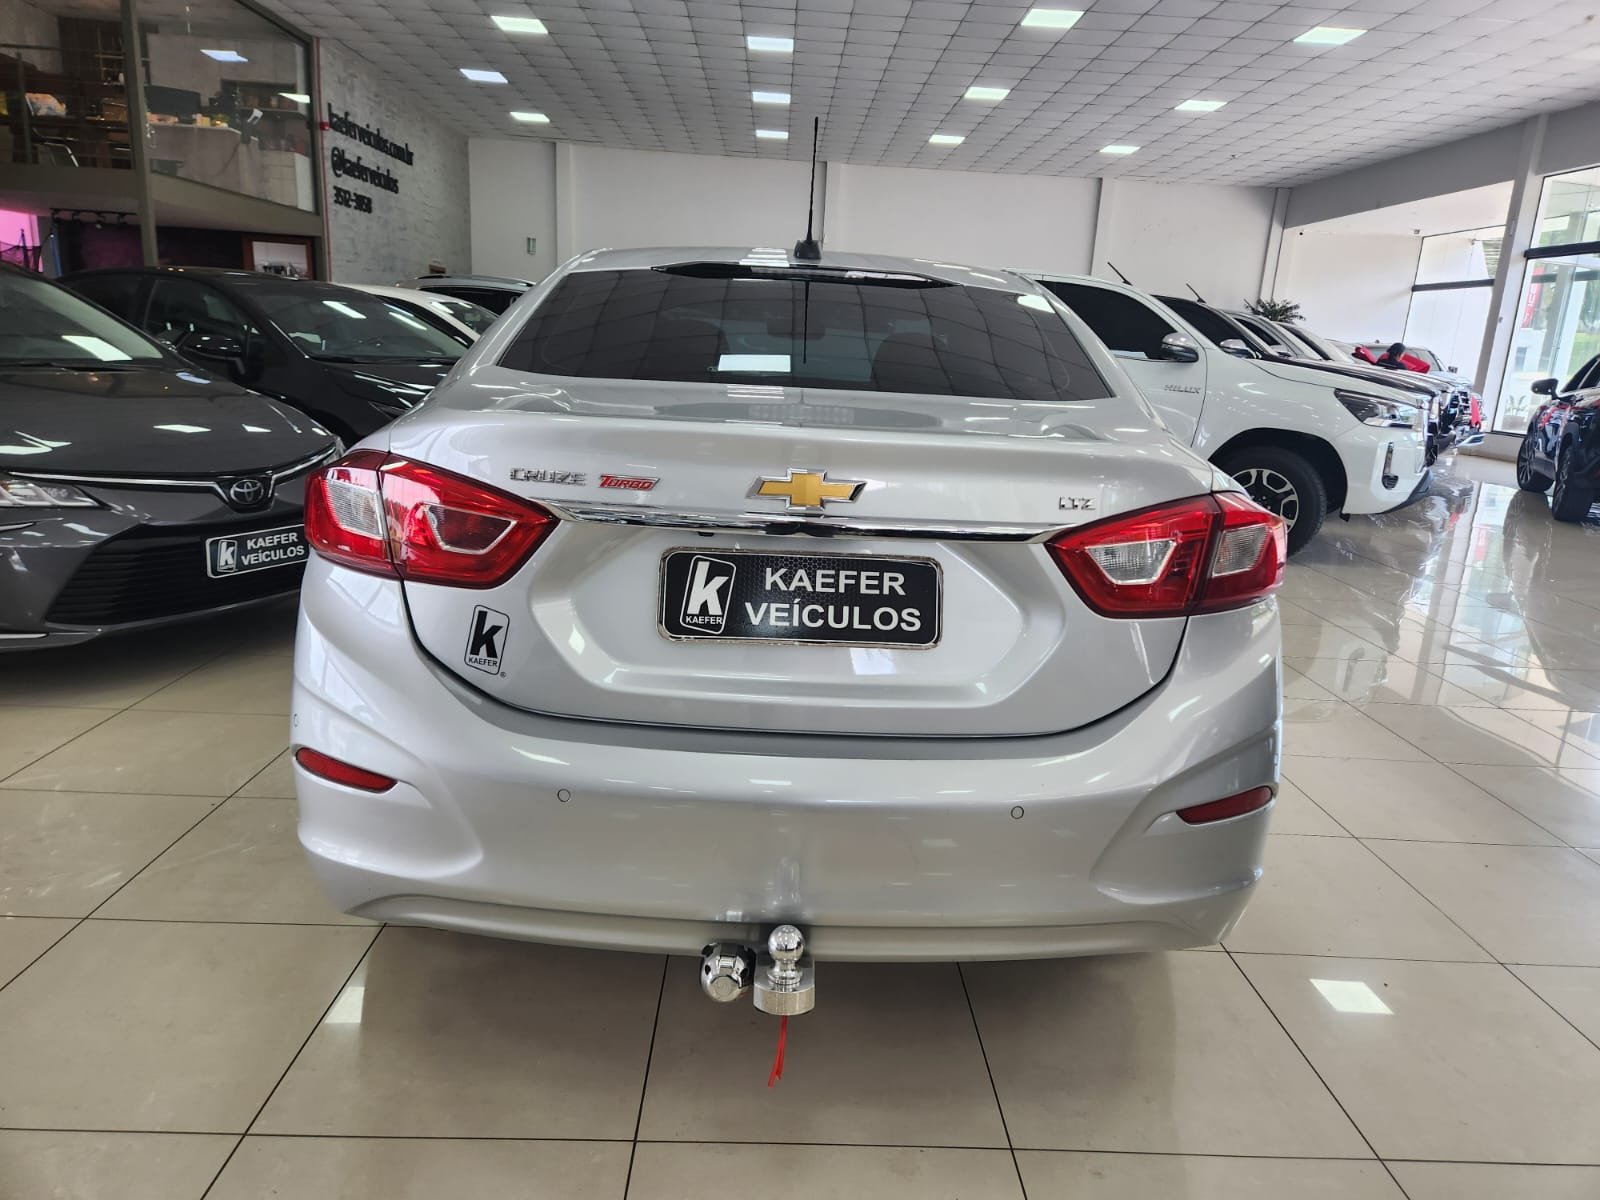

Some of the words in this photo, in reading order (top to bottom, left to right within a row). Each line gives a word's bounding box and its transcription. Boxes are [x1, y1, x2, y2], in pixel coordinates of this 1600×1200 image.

[1164, 384, 1201, 394] HILUX
[510, 468, 586, 486] CRUZE
[1058, 496, 1096, 510] LTZ
[247, 532, 298, 550] KAEFER
[241, 545, 305, 566] VEÍCULOS
[765, 567, 906, 596] KAEFER
[685, 615, 724, 625] KAEFER
[744, 599, 922, 632] VEÍCULOS
[468, 657, 498, 667] KAEFER
